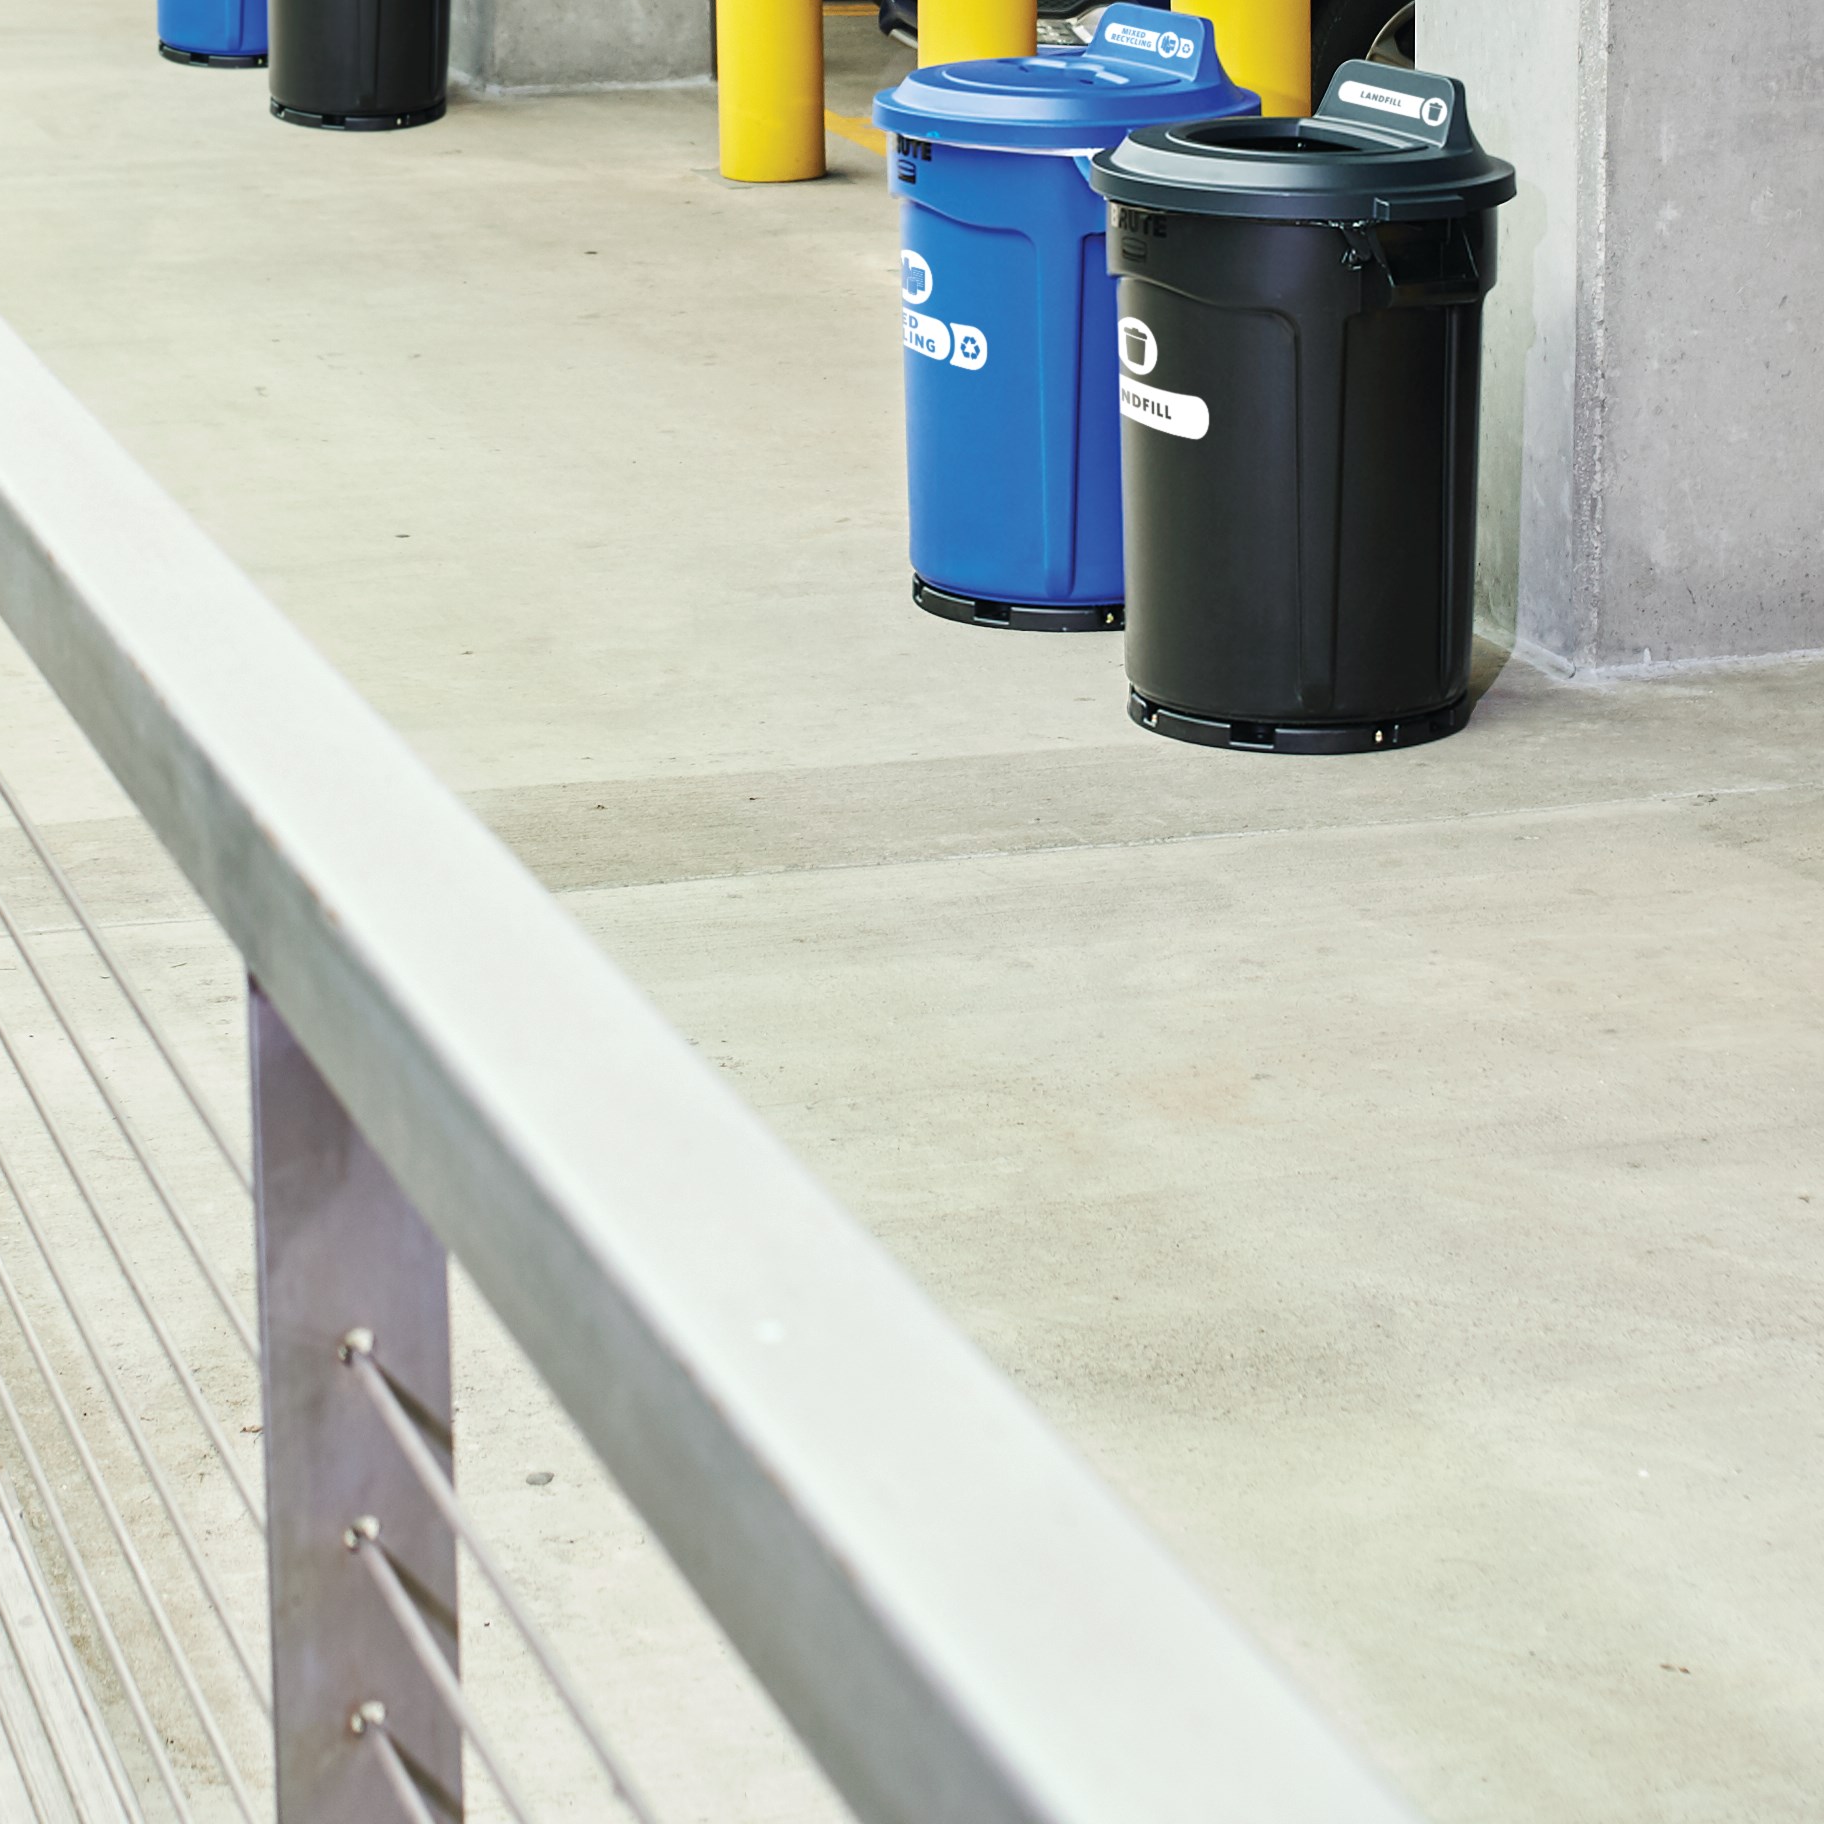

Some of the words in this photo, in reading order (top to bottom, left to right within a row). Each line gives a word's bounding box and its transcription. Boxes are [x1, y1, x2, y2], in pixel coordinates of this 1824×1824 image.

[1111, 33, 1153, 48] RECYCLING
[1121, 27, 1146, 39] MIXED
[1360, 90, 1402, 108] LANDFILL
[1121, 387, 1172, 420] NDFILL
